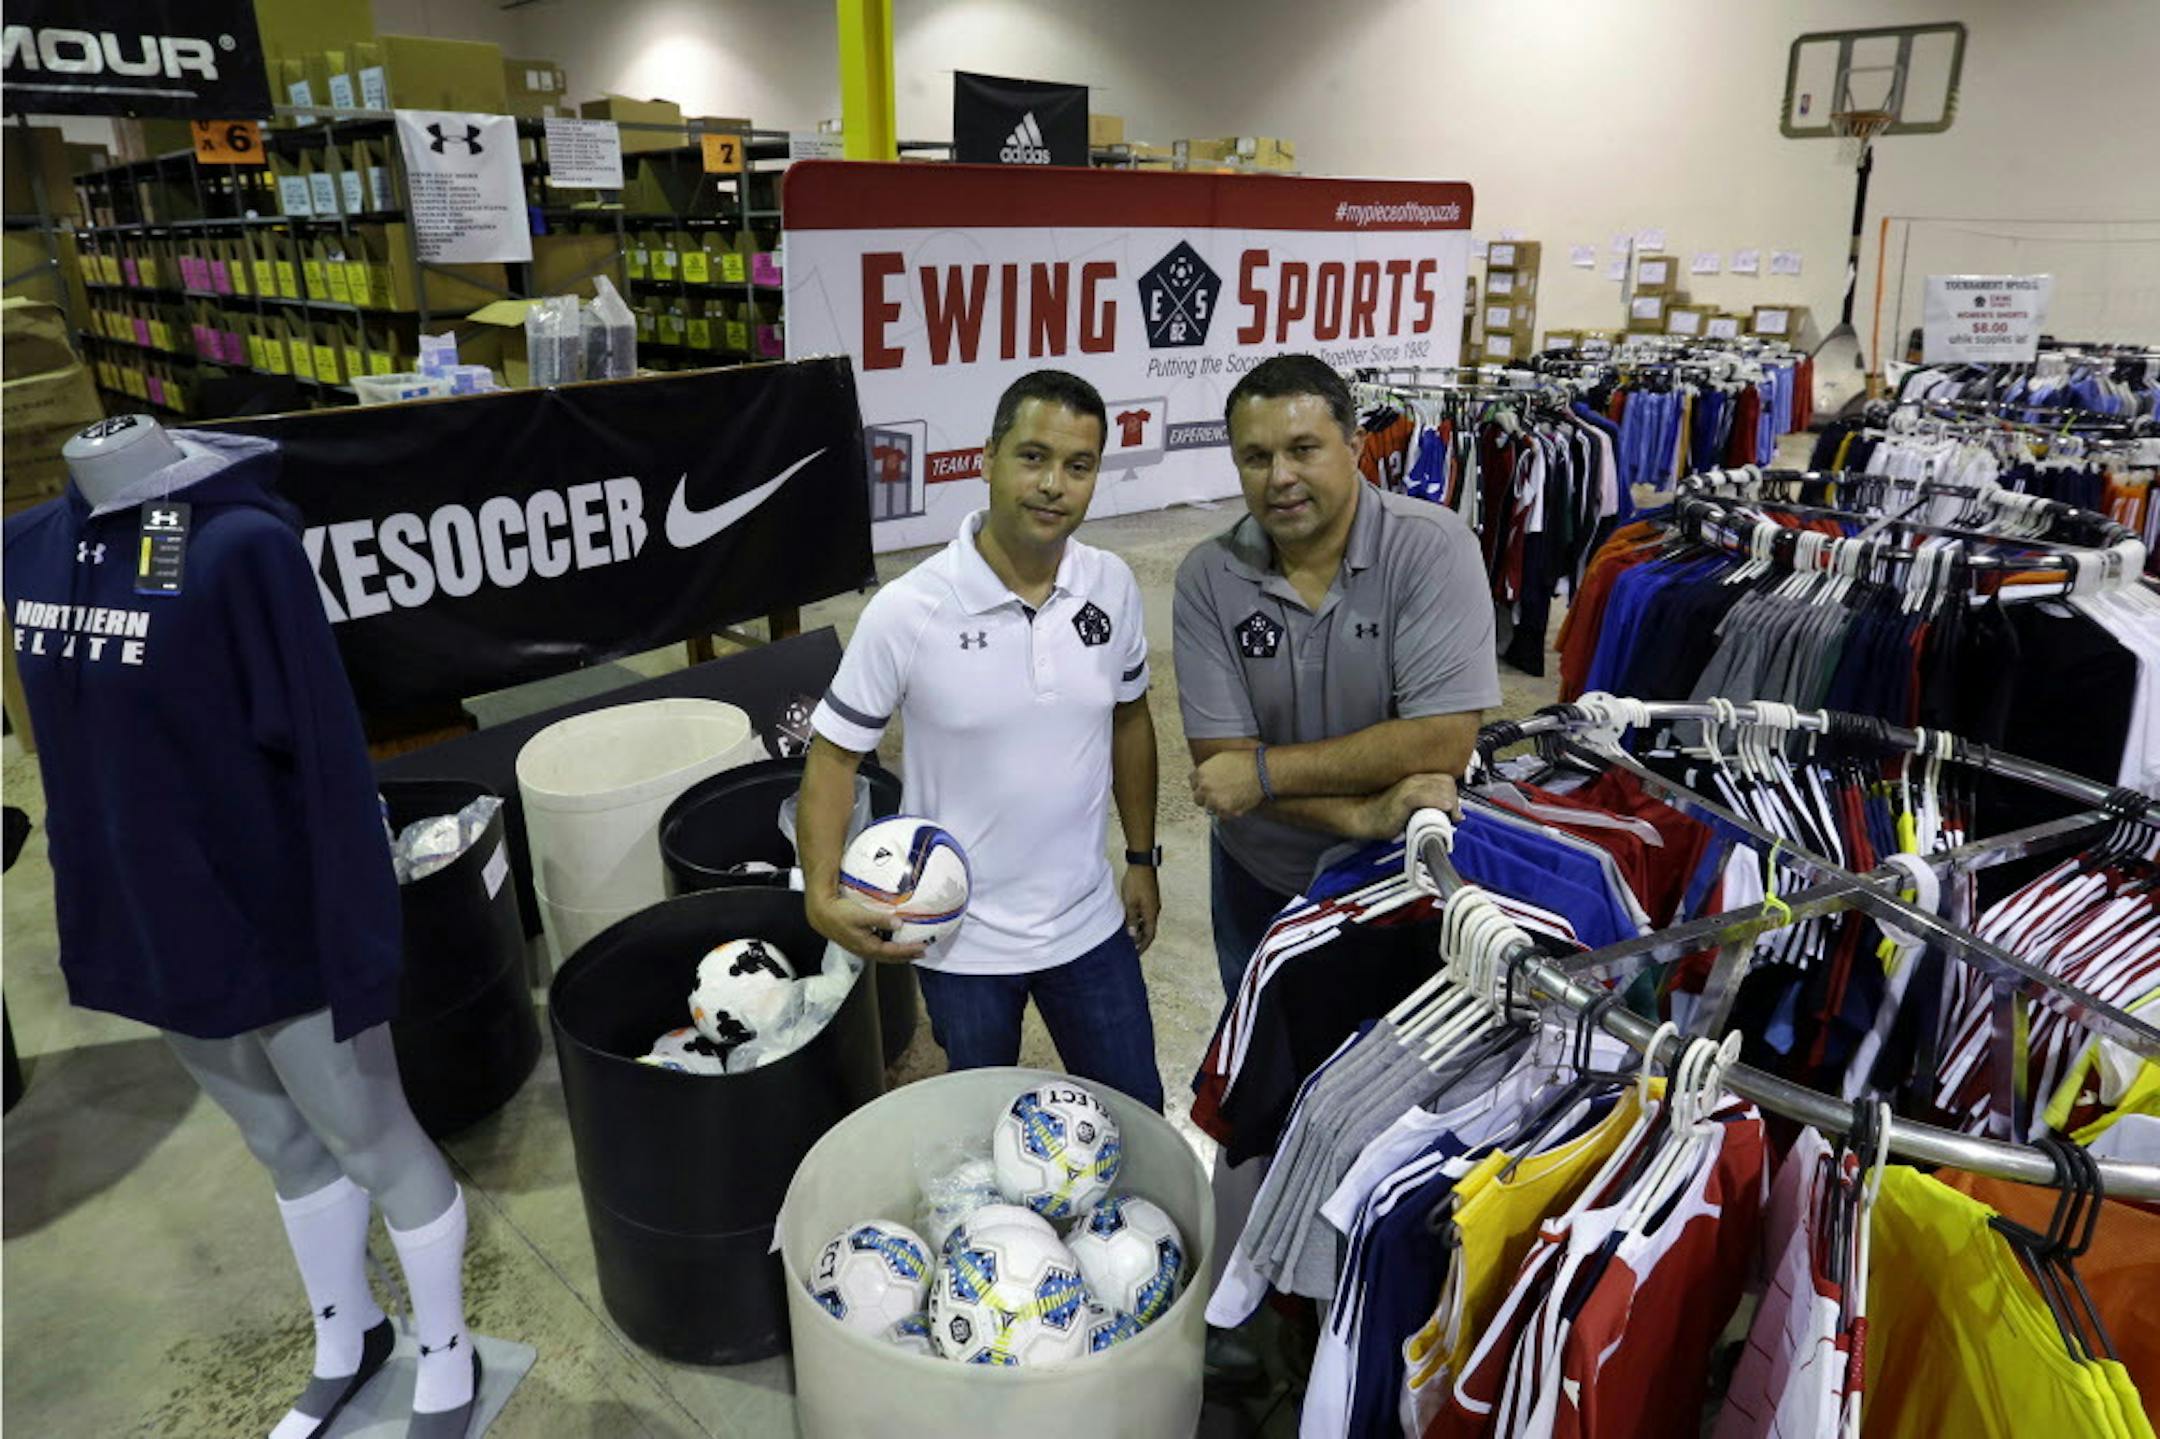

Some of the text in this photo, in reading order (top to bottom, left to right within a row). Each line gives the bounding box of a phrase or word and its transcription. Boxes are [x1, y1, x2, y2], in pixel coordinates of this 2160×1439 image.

[226, 124, 252, 152] 6
[720, 143, 734, 164] 7
[1000, 143, 1051, 164] adidas
[1335, 201, 1460, 226] #mypieceofthepuzzle
[862, 248, 1437, 371] EWING SPORTS
[1151, 289, 1208, 322] E S
[1169, 322, 1186, 342] 82
[1972, 322, 2009, 334] $8.00
[1147, 356, 1197, 379] Putting
[1201, 355, 1223, 375] the
[1370, 343, 1399, 363] Since
[1169, 425, 1230, 445] EXPERIENC
[932, 455, 973, 476] TEAM
